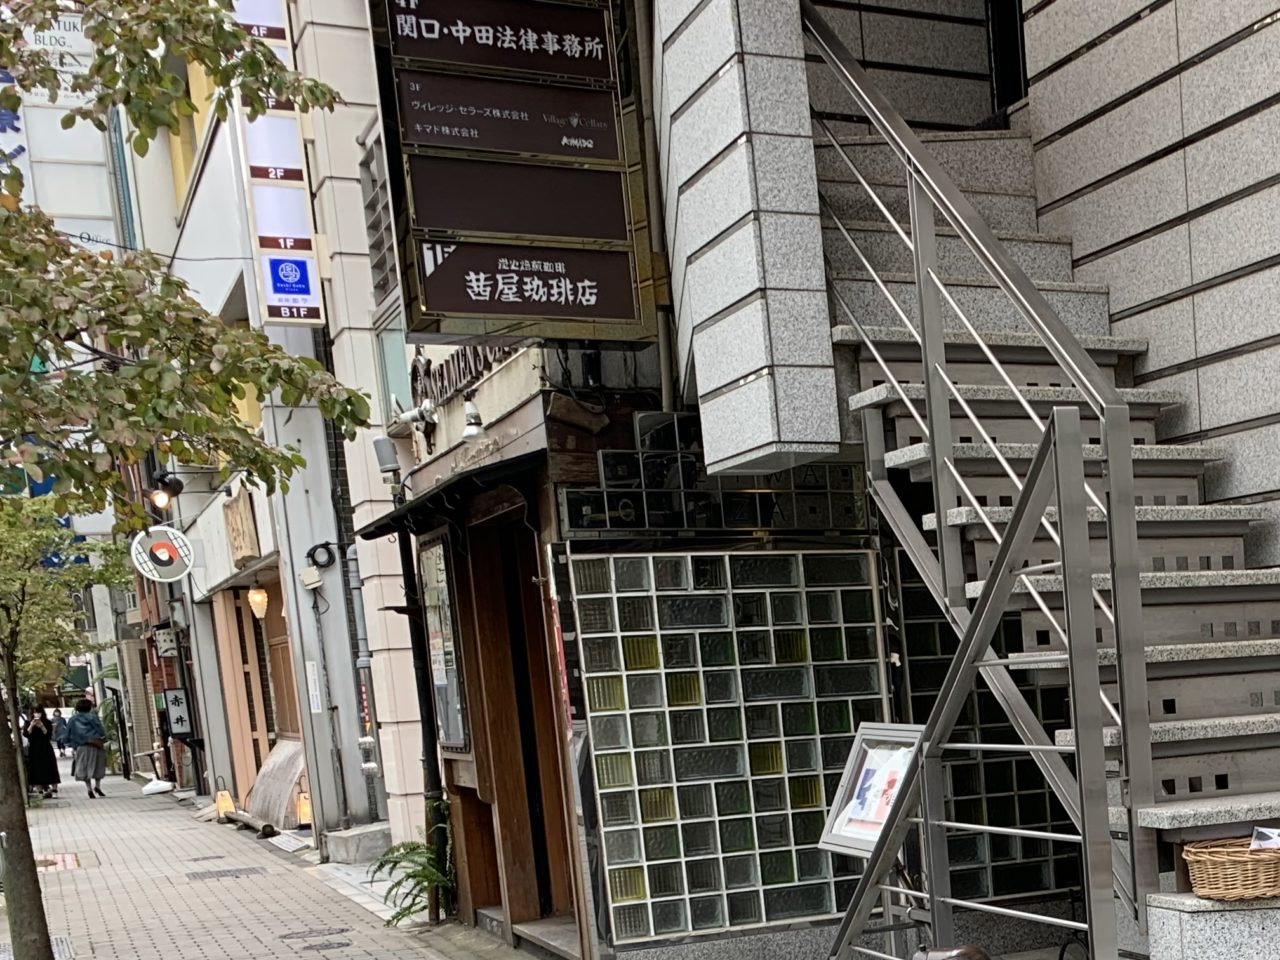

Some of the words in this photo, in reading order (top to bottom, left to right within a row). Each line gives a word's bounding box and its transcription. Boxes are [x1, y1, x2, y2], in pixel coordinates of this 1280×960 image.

[251, 26, 268, 37] 4F
[268, 168, 284, 179] 2F
[278, 238, 295, 249] 1F
[464, 271, 599, 306] 茜屋珈琲店
[281, 307, 308, 317] B1F
